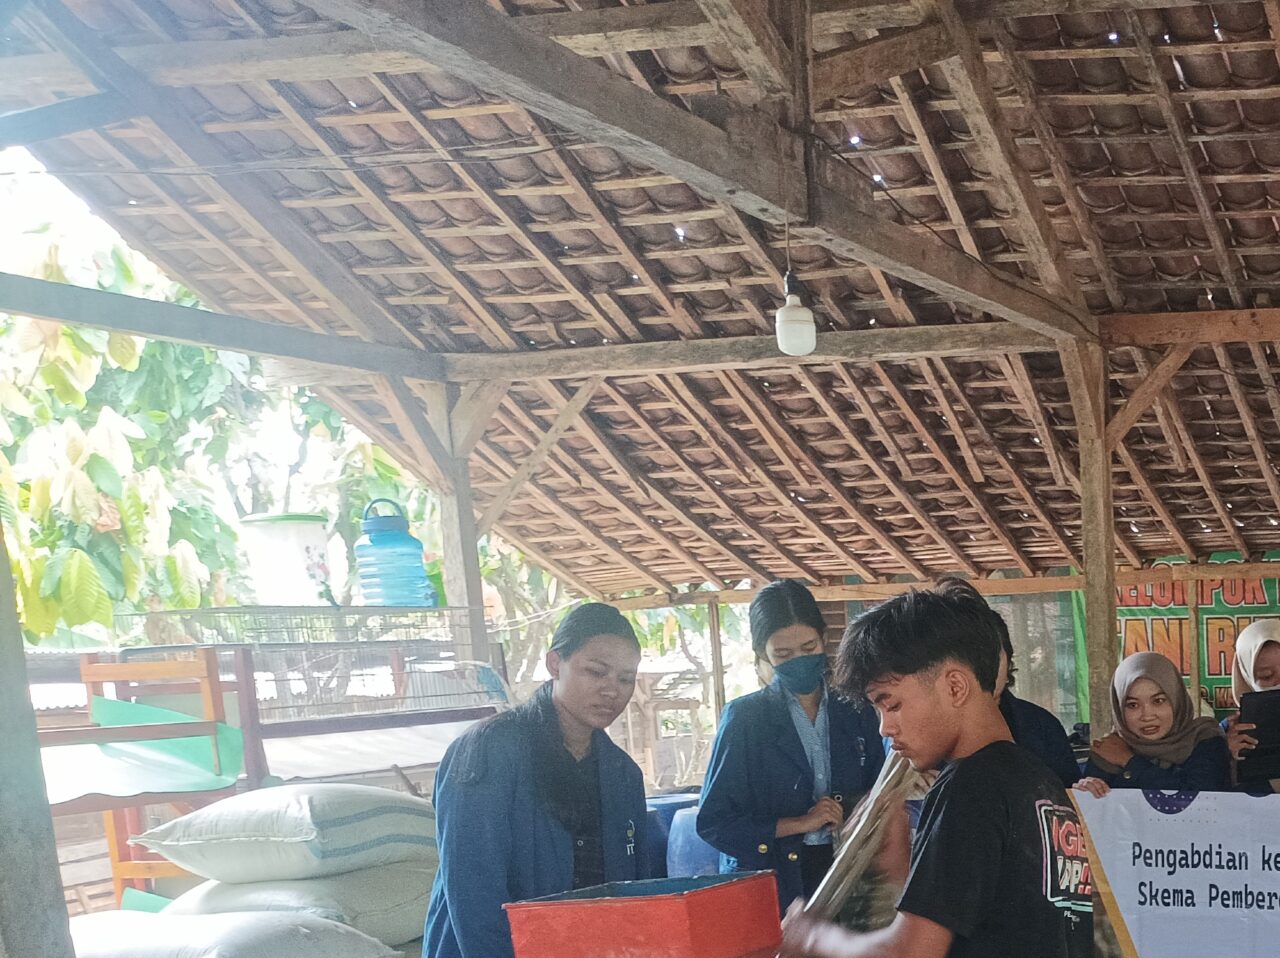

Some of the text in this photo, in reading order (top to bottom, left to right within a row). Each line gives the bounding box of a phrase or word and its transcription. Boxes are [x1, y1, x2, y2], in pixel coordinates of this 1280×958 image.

[1116, 567, 1268, 608] ELOMPOK
[1116, 615, 1191, 677] ANI
[1131, 841, 1249, 875] Pengabdian
[1138, 880, 1196, 909] Skema
